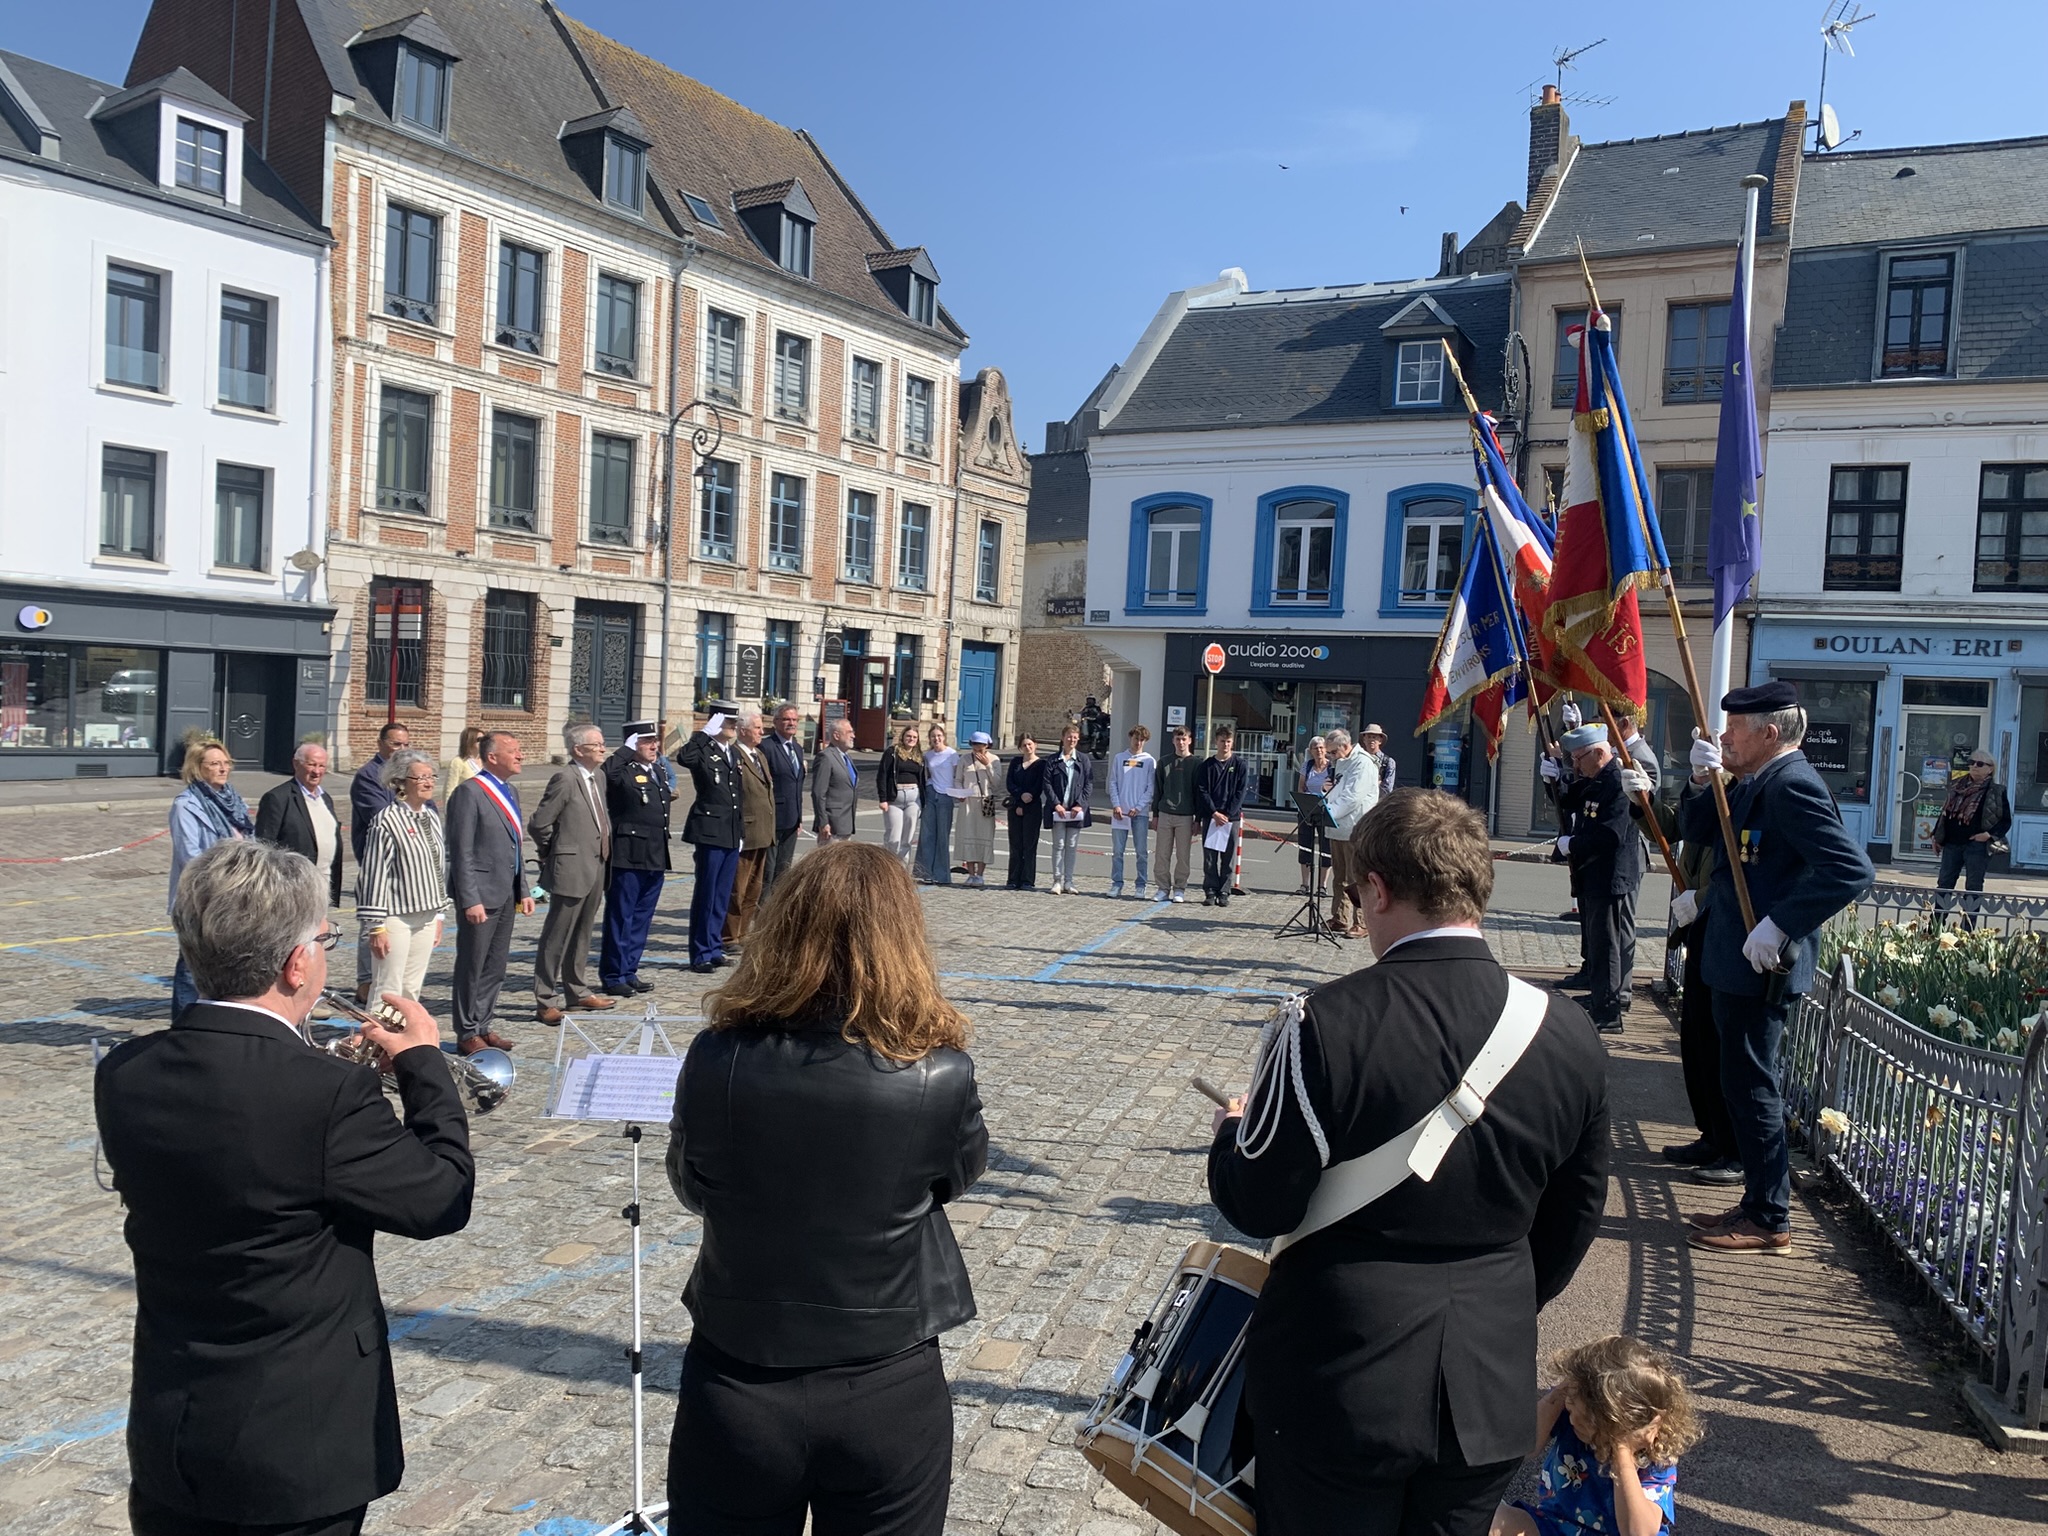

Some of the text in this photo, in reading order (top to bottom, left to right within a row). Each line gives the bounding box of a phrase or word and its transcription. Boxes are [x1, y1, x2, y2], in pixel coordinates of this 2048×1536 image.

[1062, 606, 1076, 614] PLACE
[1461, 623, 1481, 645] SUR
[1480, 611, 1500, 631] MER
[1228, 642, 1322, 659] audio 2000
[1207, 653, 1223, 663] STOP
[1250, 661, 1305, 669] L'expertise auditive
[1818, 729, 1831, 737] gré
[1821, 736, 1837, 744] blés
[1909, 736, 1929, 746] des
[1908, 746, 1931, 757] blés
